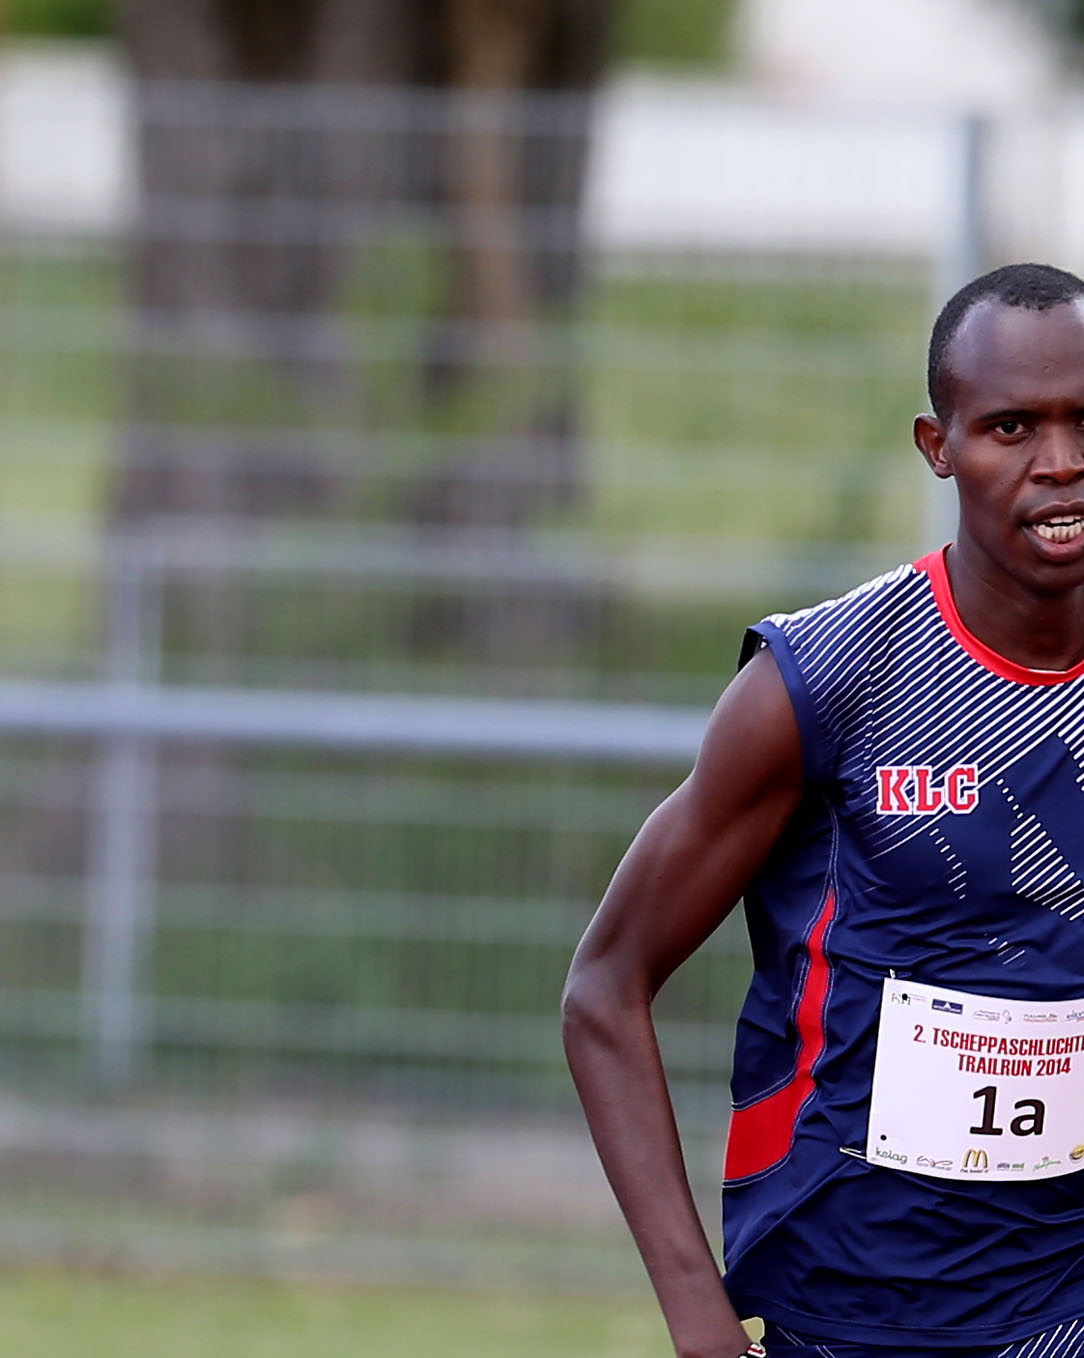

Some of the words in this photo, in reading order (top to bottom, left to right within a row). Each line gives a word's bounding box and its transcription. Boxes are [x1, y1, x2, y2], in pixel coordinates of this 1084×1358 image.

[876, 765, 979, 815] KLC
[913, 1024, 927, 1044] 2.
[958, 1053, 1033, 1077] TRAILRUN
[1036, 1057, 1071, 1077] 2014
[969, 1085, 1046, 1137] 1a
[875, 1146, 908, 1165] kelag
